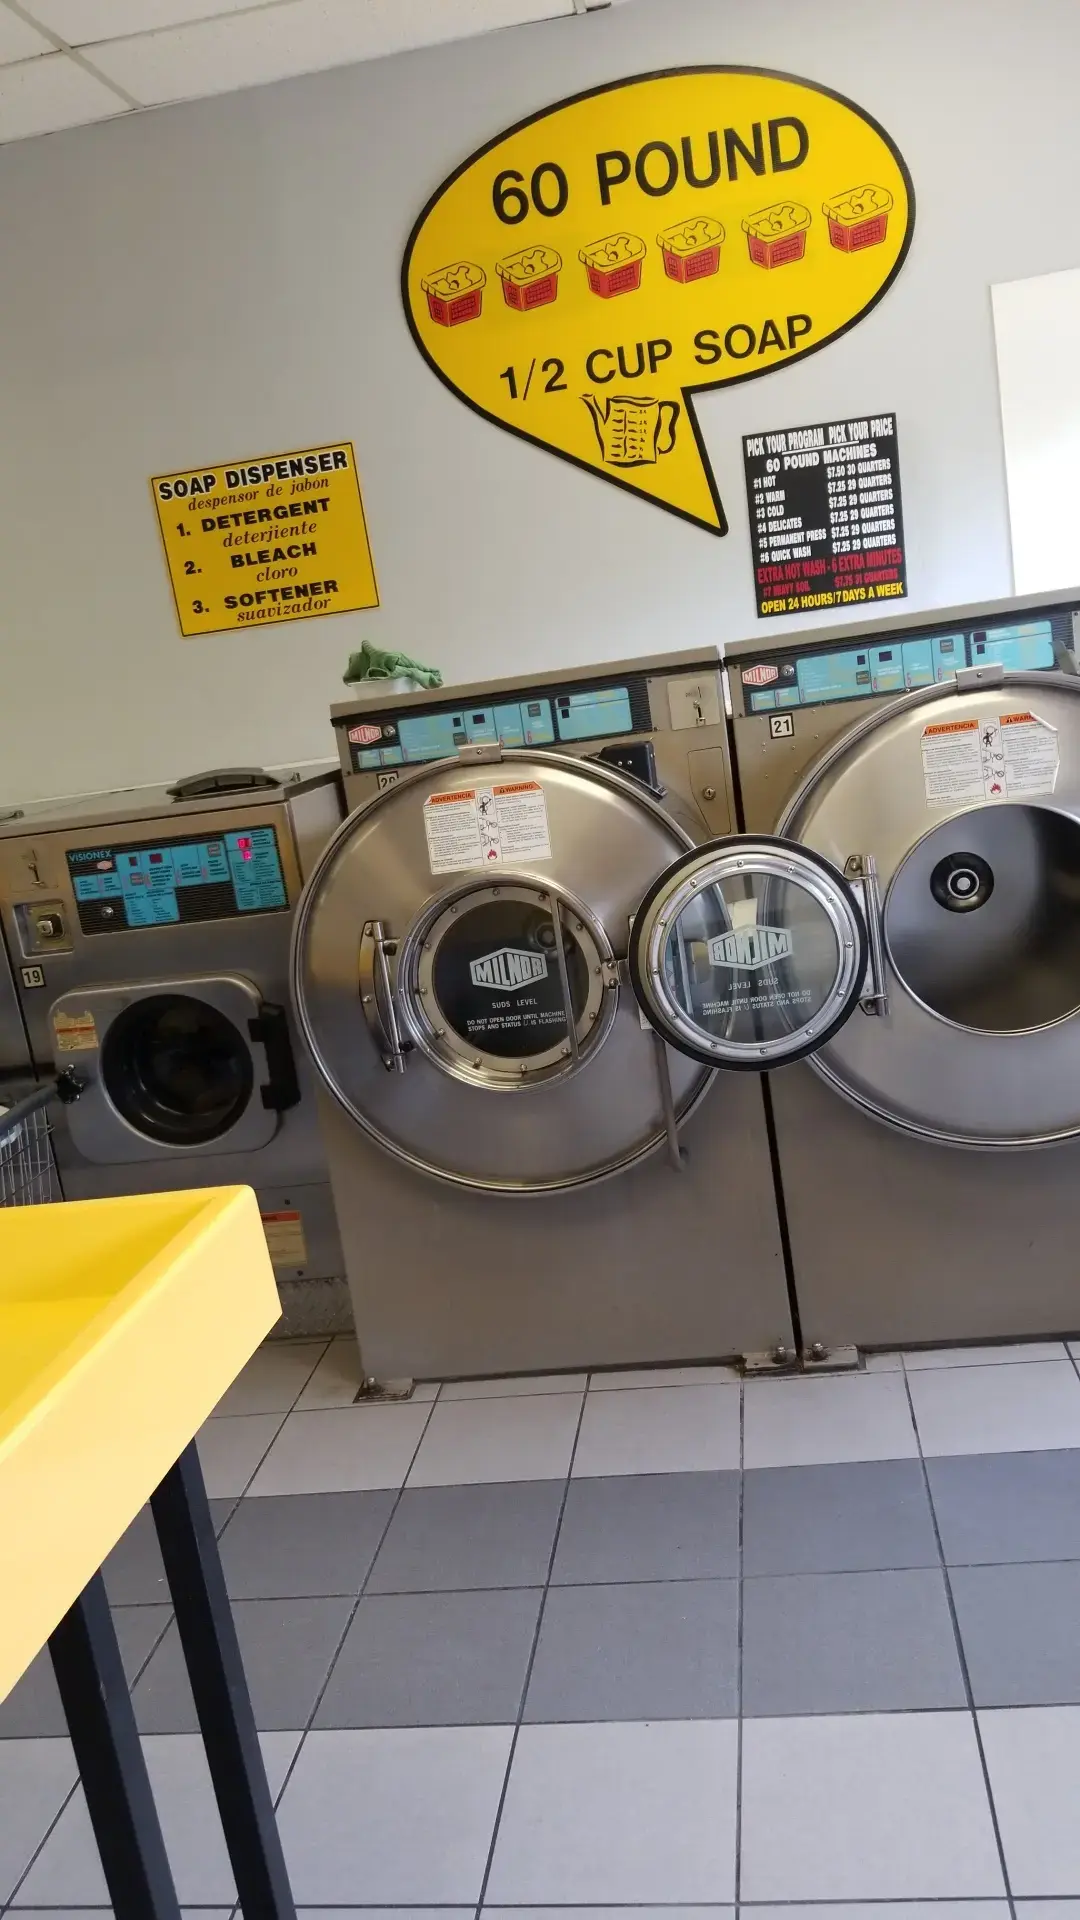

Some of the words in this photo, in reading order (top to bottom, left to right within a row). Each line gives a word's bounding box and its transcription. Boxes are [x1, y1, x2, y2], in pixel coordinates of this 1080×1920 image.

[493, 162, 568, 224] 60
[597, 116, 809, 205] POUND
[500, 358, 567, 400] 1/2
[585, 338, 672, 384] CUP
[694, 314, 812, 365] SOAP
[746, 437, 765, 457] PICK
[766, 434, 787, 454] YOUR
[788, 427, 825, 450] PROGRAM
[828, 424, 847, 444] PICK
[848, 421, 869, 441] YOUR
[870, 417, 893, 438] PRICE
[766, 458, 781, 473] 60
[783, 452, 820, 470] POUND
[823, 443, 877, 464] MACHINES
[158, 474, 216, 500] SOAP
[225, 450, 348, 489] DISPENSER
[753, 477, 762, 489] #1
[763, 475, 776, 488] HOT
[826, 465, 845, 480] $7.50
[847, 463, 856, 476] 30
[857, 458, 891, 474] QUARTERS
[188, 490, 259, 511] despensor
[266, 484, 283, 497] de
[754, 493, 764, 505] #2
[766, 490, 786, 503] WARM
[827, 480, 846, 495] $7.25
[847, 479, 856, 490] 29
[858, 473, 892, 489] QUARTERS
[756, 507, 765, 519] #3
[767, 504, 784, 518] COLD
[829, 495, 847, 510] $7.25
[848, 494, 858, 506] 29
[859, 488, 894, 504] QUARTERS
[176, 523, 191, 536] 1.
[201, 498, 330, 532] DETERGENT
[757, 522, 767, 534] #4
[768, 517, 802, 532] DELICATES
[830, 510, 848, 524] $7.25
[850, 508, 859, 520] 29
[860, 504, 895, 519] QUARTERS
[223, 522, 317, 547] deterjiente
[759, 538, 768, 549] #5
[769, 531, 805, 547] PERMANENT
[806, 528, 827, 542] PRESS
[831, 525, 850, 539] $7.25
[851, 524, 860, 535] 29
[862, 518, 896, 534] QUARTERS
[760, 552, 770, 563] #6
[771, 549, 792, 562] QUICK
[792, 546, 812, 559] WASH
[832, 540, 851, 554] $7.25
[852, 539, 861, 550] 29
[863, 533, 896, 549] QUARTERS
[184, 561, 202, 575] 2.
[230, 542, 317, 568] BLEACH
[757, 566, 784, 584] EXTRA
[785, 563, 800, 580] HOT
[802, 559, 826, 577] WASH
[832, 556, 838, 573] 6
[839, 553, 865, 572] EXTRA
[866, 548, 902, 569] MINUTES
[256, 567, 298, 582] cloro
[192, 600, 210, 614] 3.
[224, 579, 339, 609] SOFTENER
[237, 597, 331, 622] suavizador
[761, 599, 786, 614] OPEN
[788, 597, 800, 610] 24
[842, 587, 866, 602] DAYS
[868, 586, 875, 599] A
[876, 582, 904, 597] WEEK
[743, 666, 776, 684] MILNOR
[351, 726, 380, 743] MILNOR
[774, 719, 790, 734] 21
[928, 722, 974, 734] ADVERTENCIA
[431, 793, 472, 804] ADVERTENCIA
[506, 784, 534, 793] WARNING
[69, 850, 112, 862] VISIONEX
[24, 970, 41, 984] 19
[475, 952, 543, 986] MILNOR
[489, 1016, 504, 1024] OPEN
[540, 1010, 566, 1018] MACHINE
[491, 1001, 511, 1009] SUDS
[516, 998, 538, 1007] LEVEL
[538, 1016, 567, 1025] FLASHING
